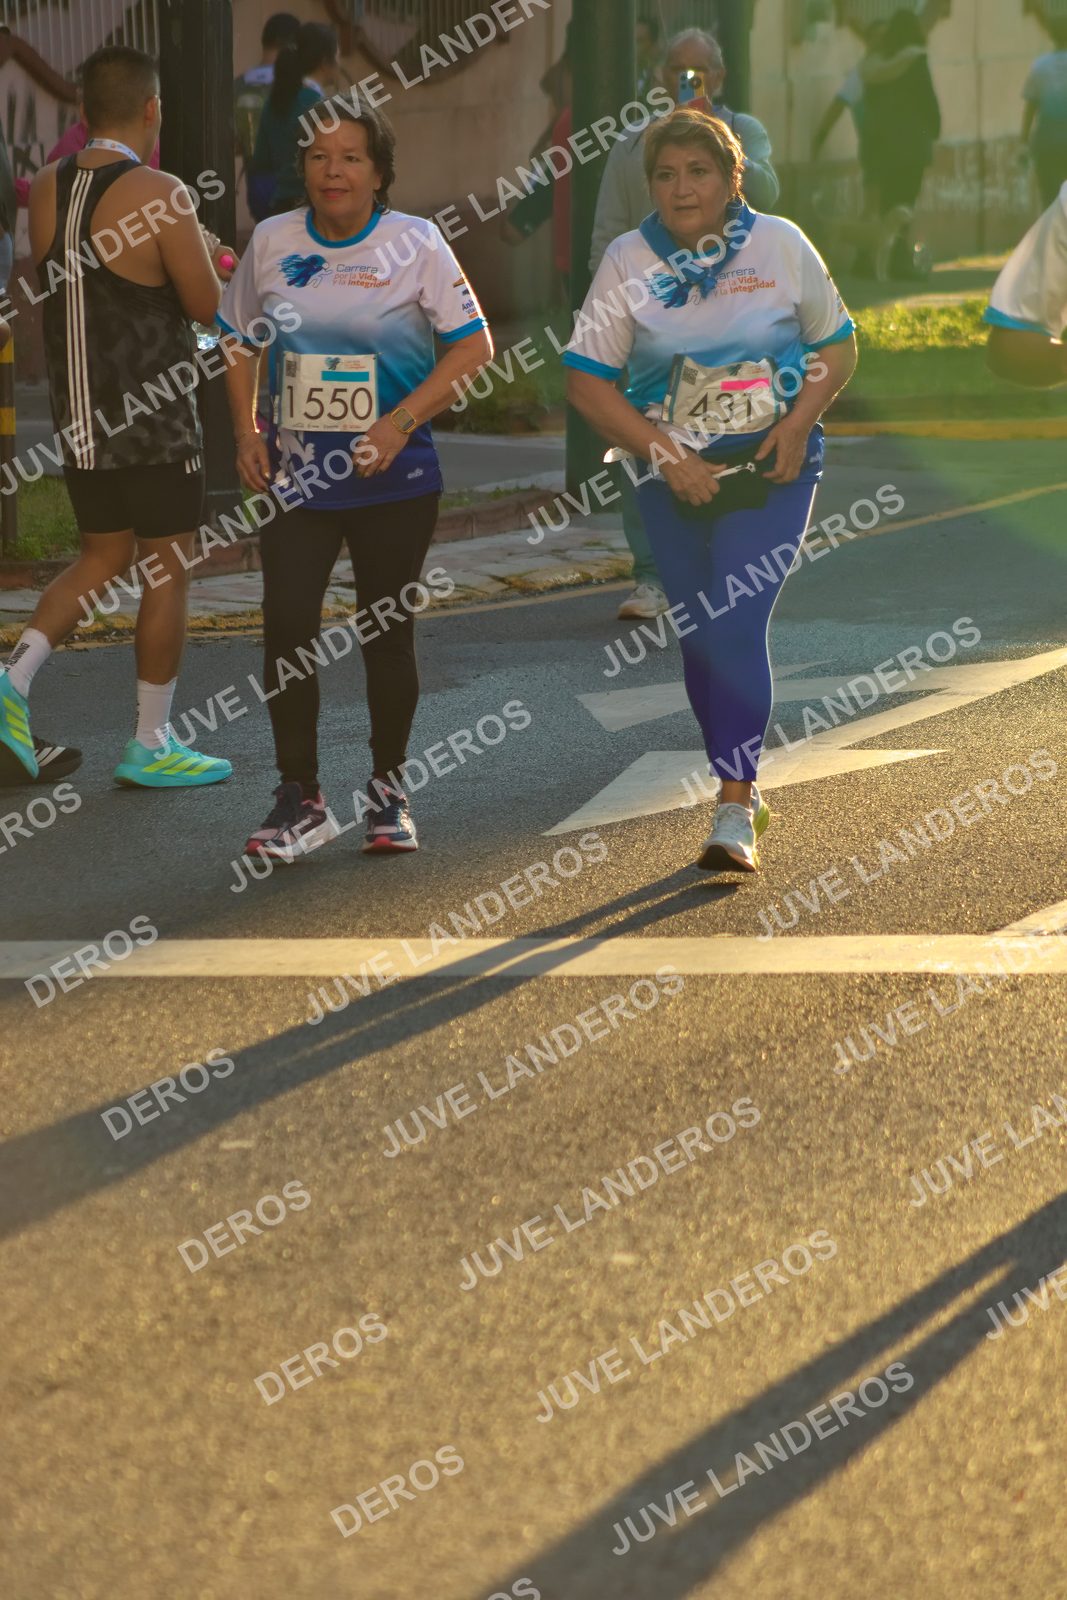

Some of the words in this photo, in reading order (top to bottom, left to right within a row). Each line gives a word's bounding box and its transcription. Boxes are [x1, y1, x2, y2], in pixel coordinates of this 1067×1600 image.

[336, 264, 378, 274] Carrera
[717, 267, 756, 280] arrera
[358, 272, 378, 281] Vida
[737, 275, 758, 284] Vida
[287, 385, 373, 420] 1550
[687, 391, 752, 424] 431
